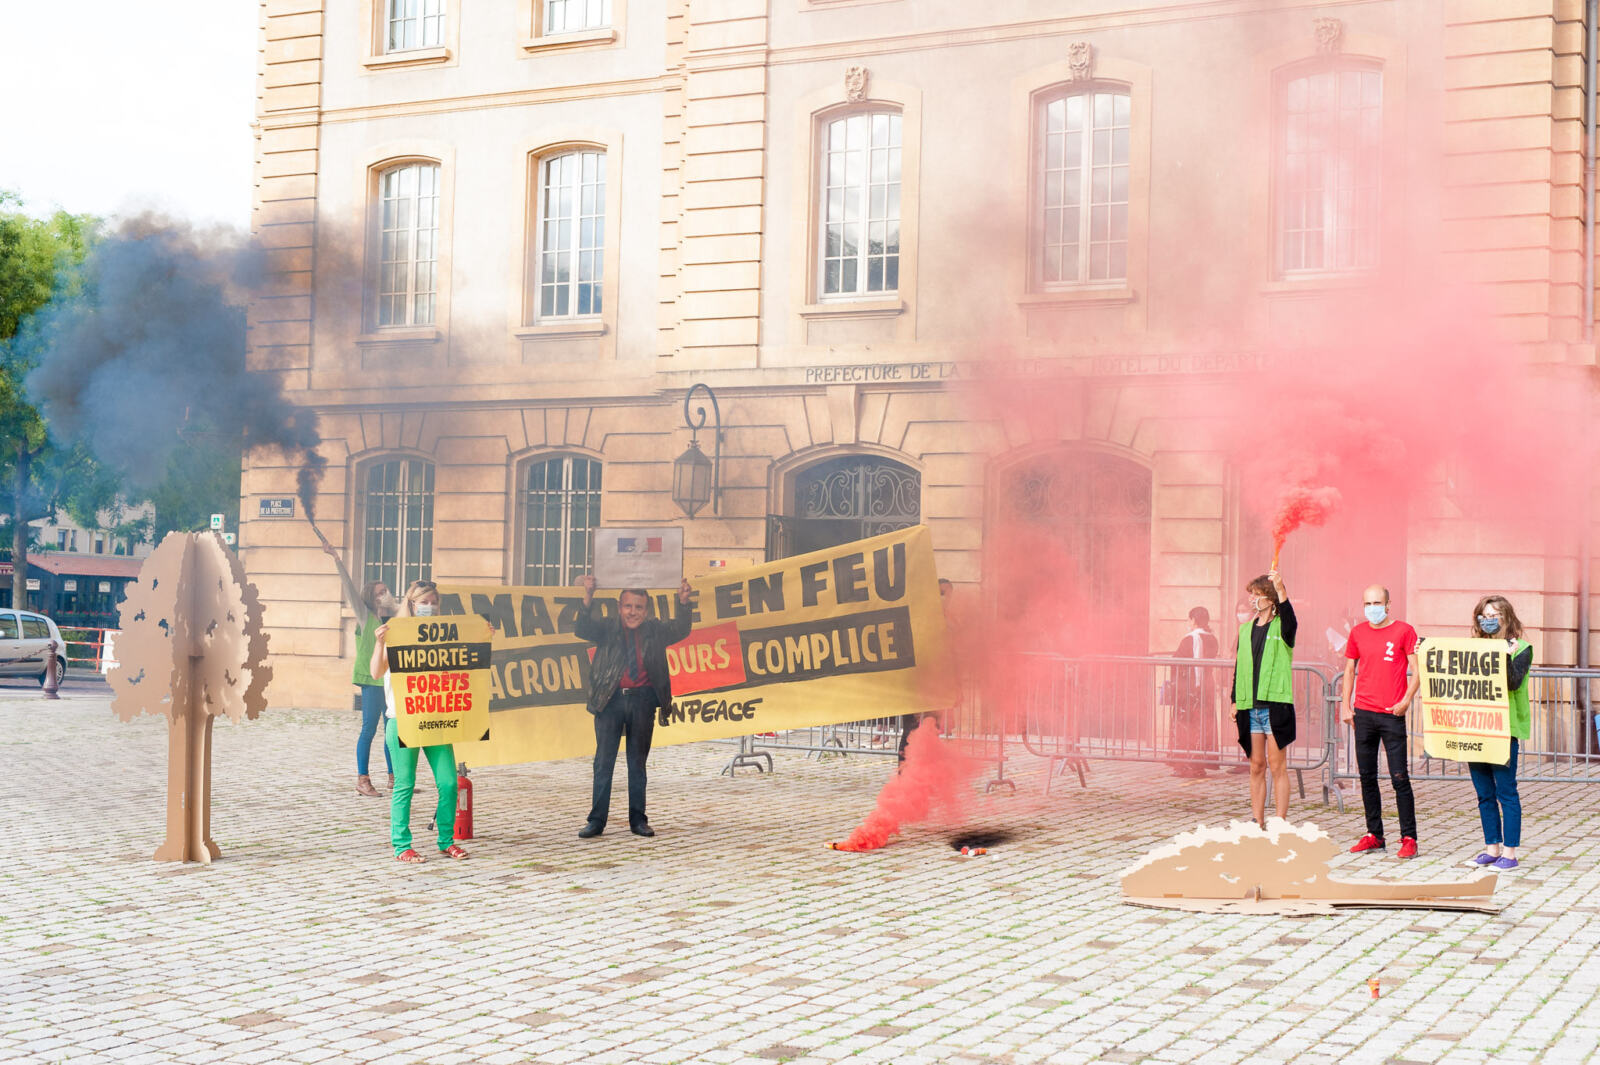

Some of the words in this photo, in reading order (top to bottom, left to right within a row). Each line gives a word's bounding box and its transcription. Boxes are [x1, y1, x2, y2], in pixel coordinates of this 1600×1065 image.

[805, 365, 902, 383] PREFECTURE
[910, 364, 931, 379] DE
[939, 363, 959, 378] LA
[715, 571, 785, 619] EN
[800, 542, 906, 608] FEU
[418, 622, 459, 643] SOJA
[490, 654, 582, 700] ACRON
[666, 638, 731, 677] OURS
[748, 622, 898, 676] COMPLICE
[1426, 647, 1500, 676] ÉLEVAGE
[406, 671, 470, 694] FORÊTS
[405, 692, 472, 715] BRÛLÉES
[658, 697, 764, 728] NPEACE
[418, 719, 459, 731] GREENPEACE
[1431, 704, 1503, 731] DÉFORESTATION
